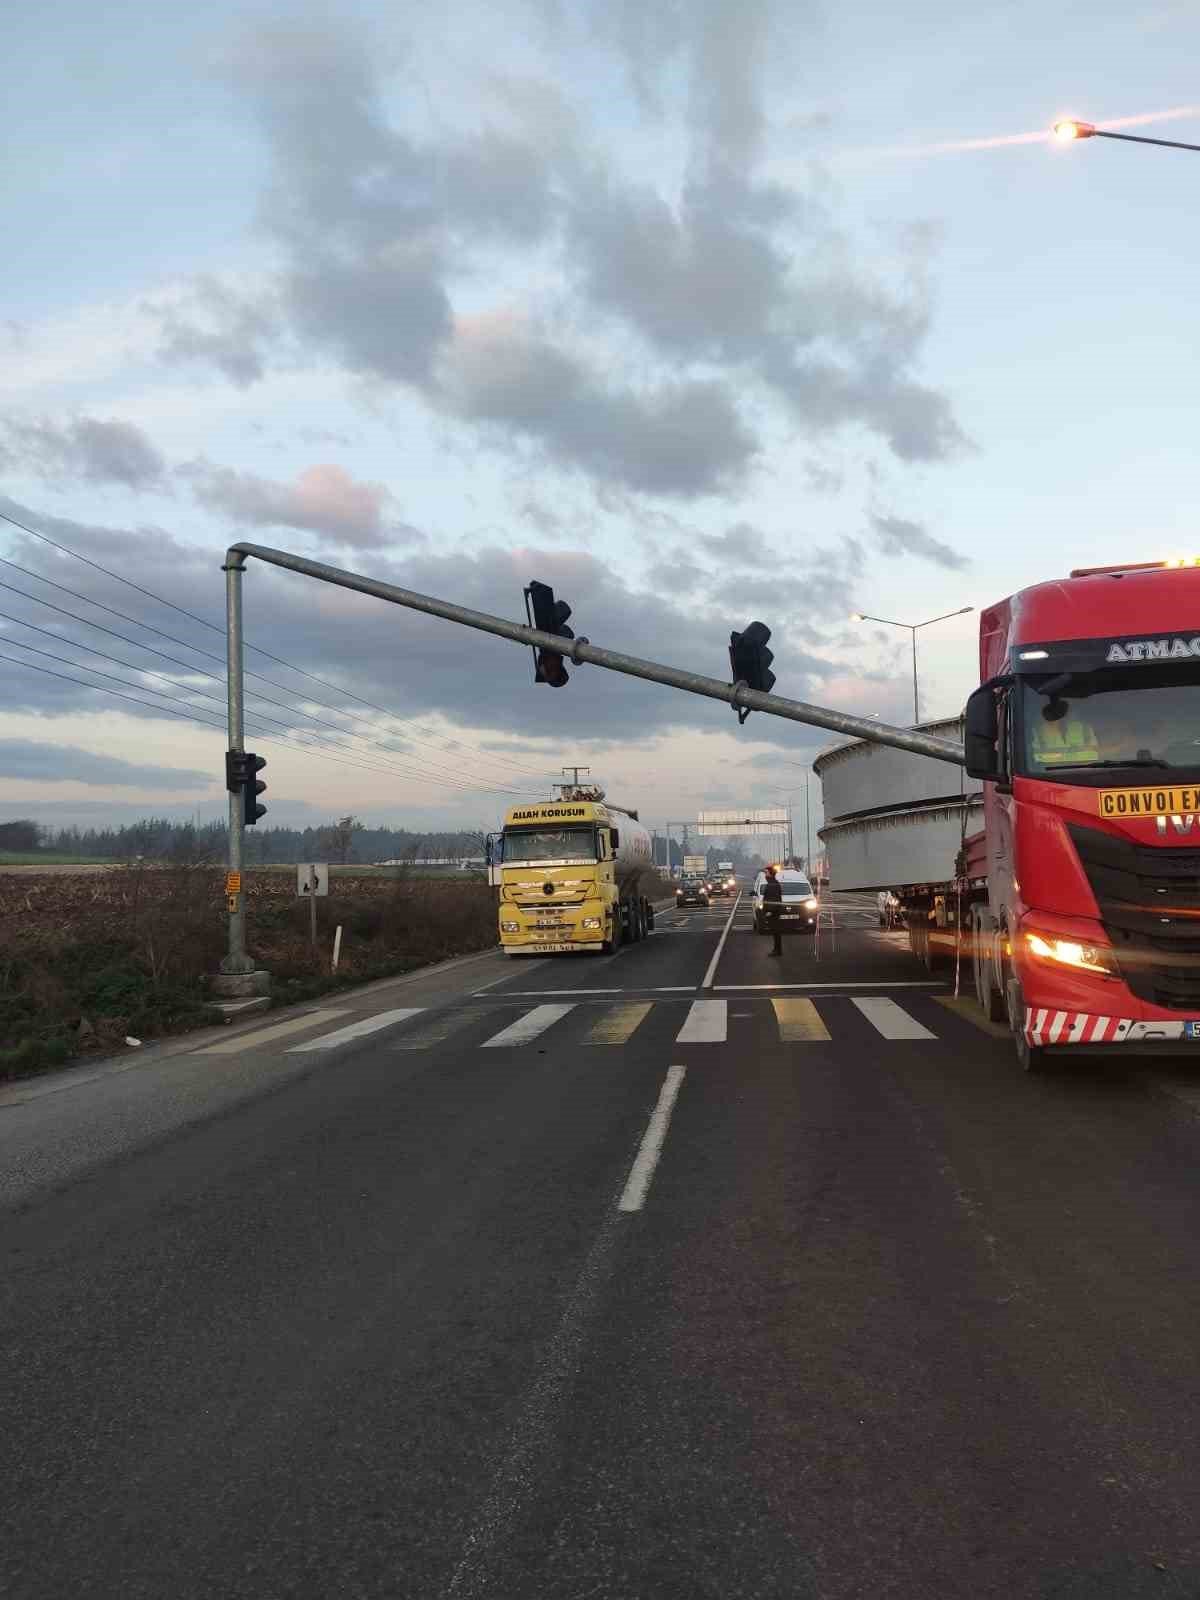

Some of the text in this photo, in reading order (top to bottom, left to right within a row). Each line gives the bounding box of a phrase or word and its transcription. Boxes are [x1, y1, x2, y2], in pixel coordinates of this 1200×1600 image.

[1104, 791, 1174, 813] CONVOI
[512, 808, 585, 819] ALLAH KORUSUN
